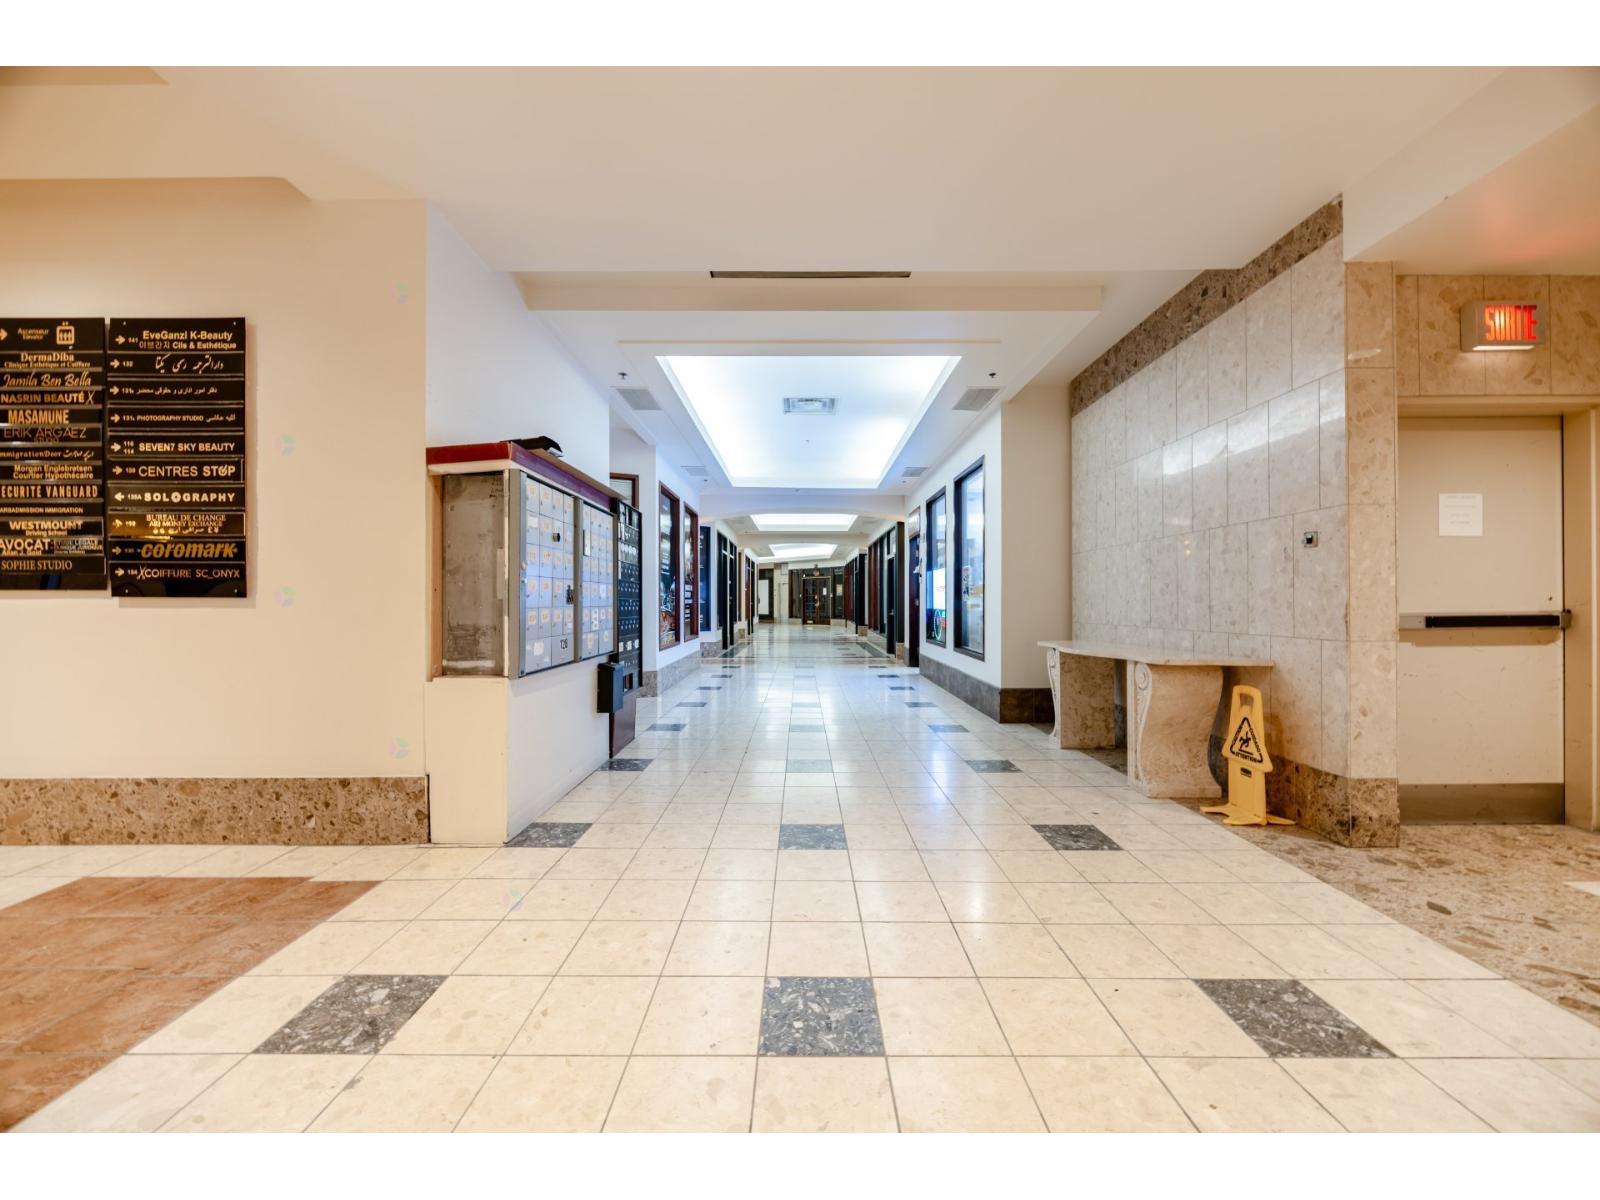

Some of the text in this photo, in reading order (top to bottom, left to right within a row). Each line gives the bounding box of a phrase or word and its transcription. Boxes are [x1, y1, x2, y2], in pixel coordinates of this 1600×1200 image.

[1484, 304, 1537, 341] SORTIE
[190, 330, 233, 342] K-Beauty
[20, 352, 75, 362] DermaDiba
[3, 368, 92, 388] Jamila Ben Bella
[0, 391, 85, 403] NASRIN BEAUTÉ
[8, 409, 70, 424] MASAMUNE
[3, 427, 87, 438] ERIK ARGAEZ
[138, 443, 235, 452] SEVEN7 SKY BEAUTY
[14, 464, 42, 474] Morgan
[138, 465, 199, 477] CENTRES
[202, 464, 236, 477] STOP
[45, 485, 98, 498] VANGUARD
[144, 492, 235, 503] SOLOGRAPHY
[9, 520, 84, 530] WESTMOUNT
[0, 538, 51, 551] AVOCAT
[141, 543, 236, 558] coromark
[1, 560, 73, 570] SOPHIE STUDIO
[144, 568, 192, 579] COIFFURE
